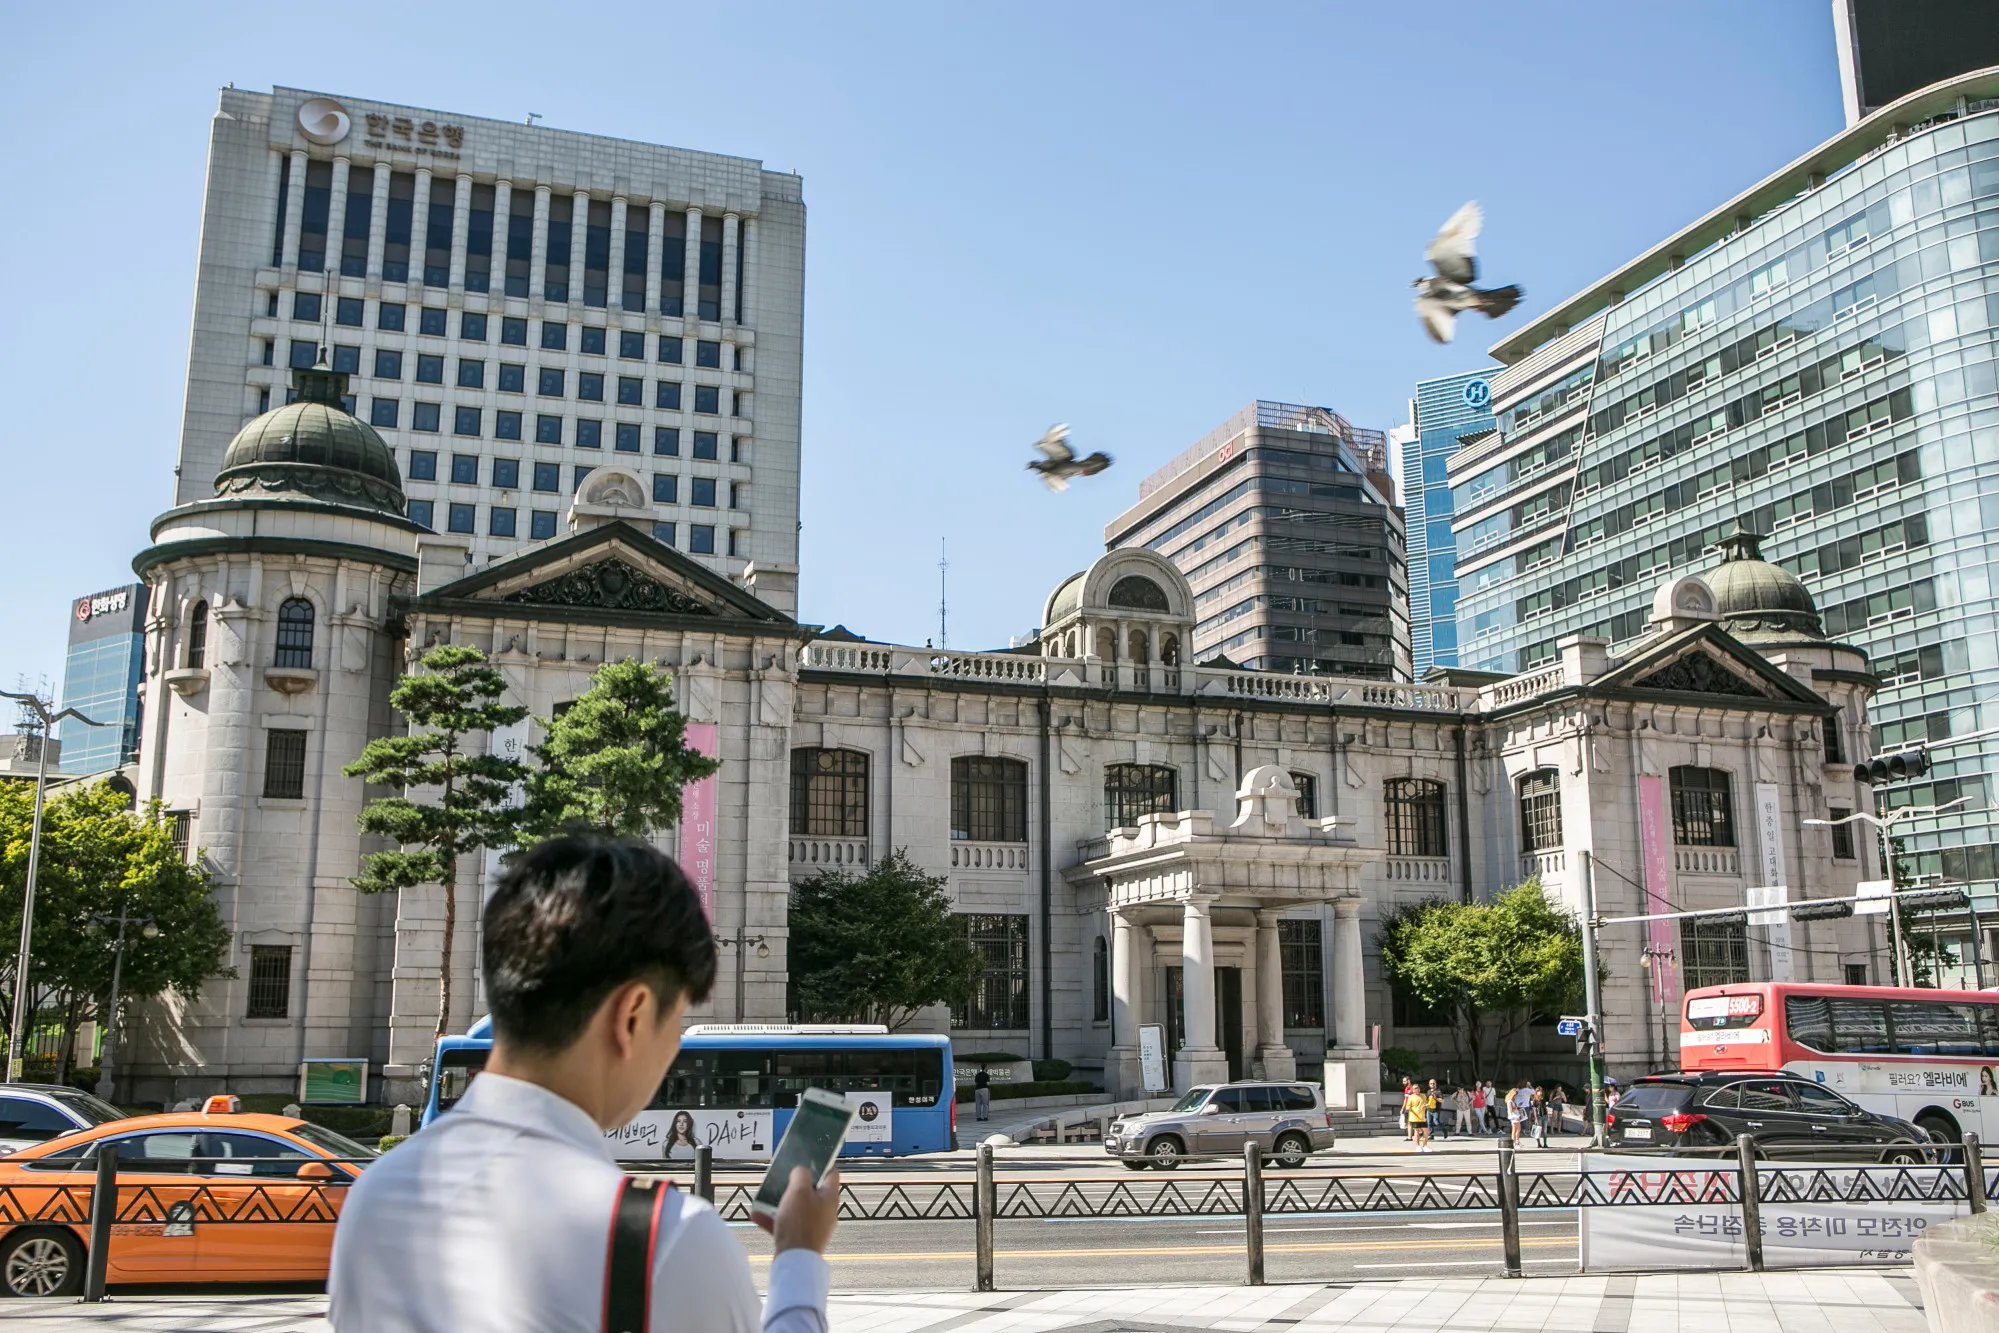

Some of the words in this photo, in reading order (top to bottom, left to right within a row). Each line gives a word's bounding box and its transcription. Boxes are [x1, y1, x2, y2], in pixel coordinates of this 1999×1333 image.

[365, 112, 464, 149] 한국은행
[696, 820, 710, 853] 미술
[696, 859, 710, 909] 명품전
[1728, 997, 1758, 1014] 5500-2
[1888, 1073, 1921, 1086] 필러요?
[1923, 1071, 1968, 1088] 엘라비에
[1961, 1100, 1975, 1108] BUS
